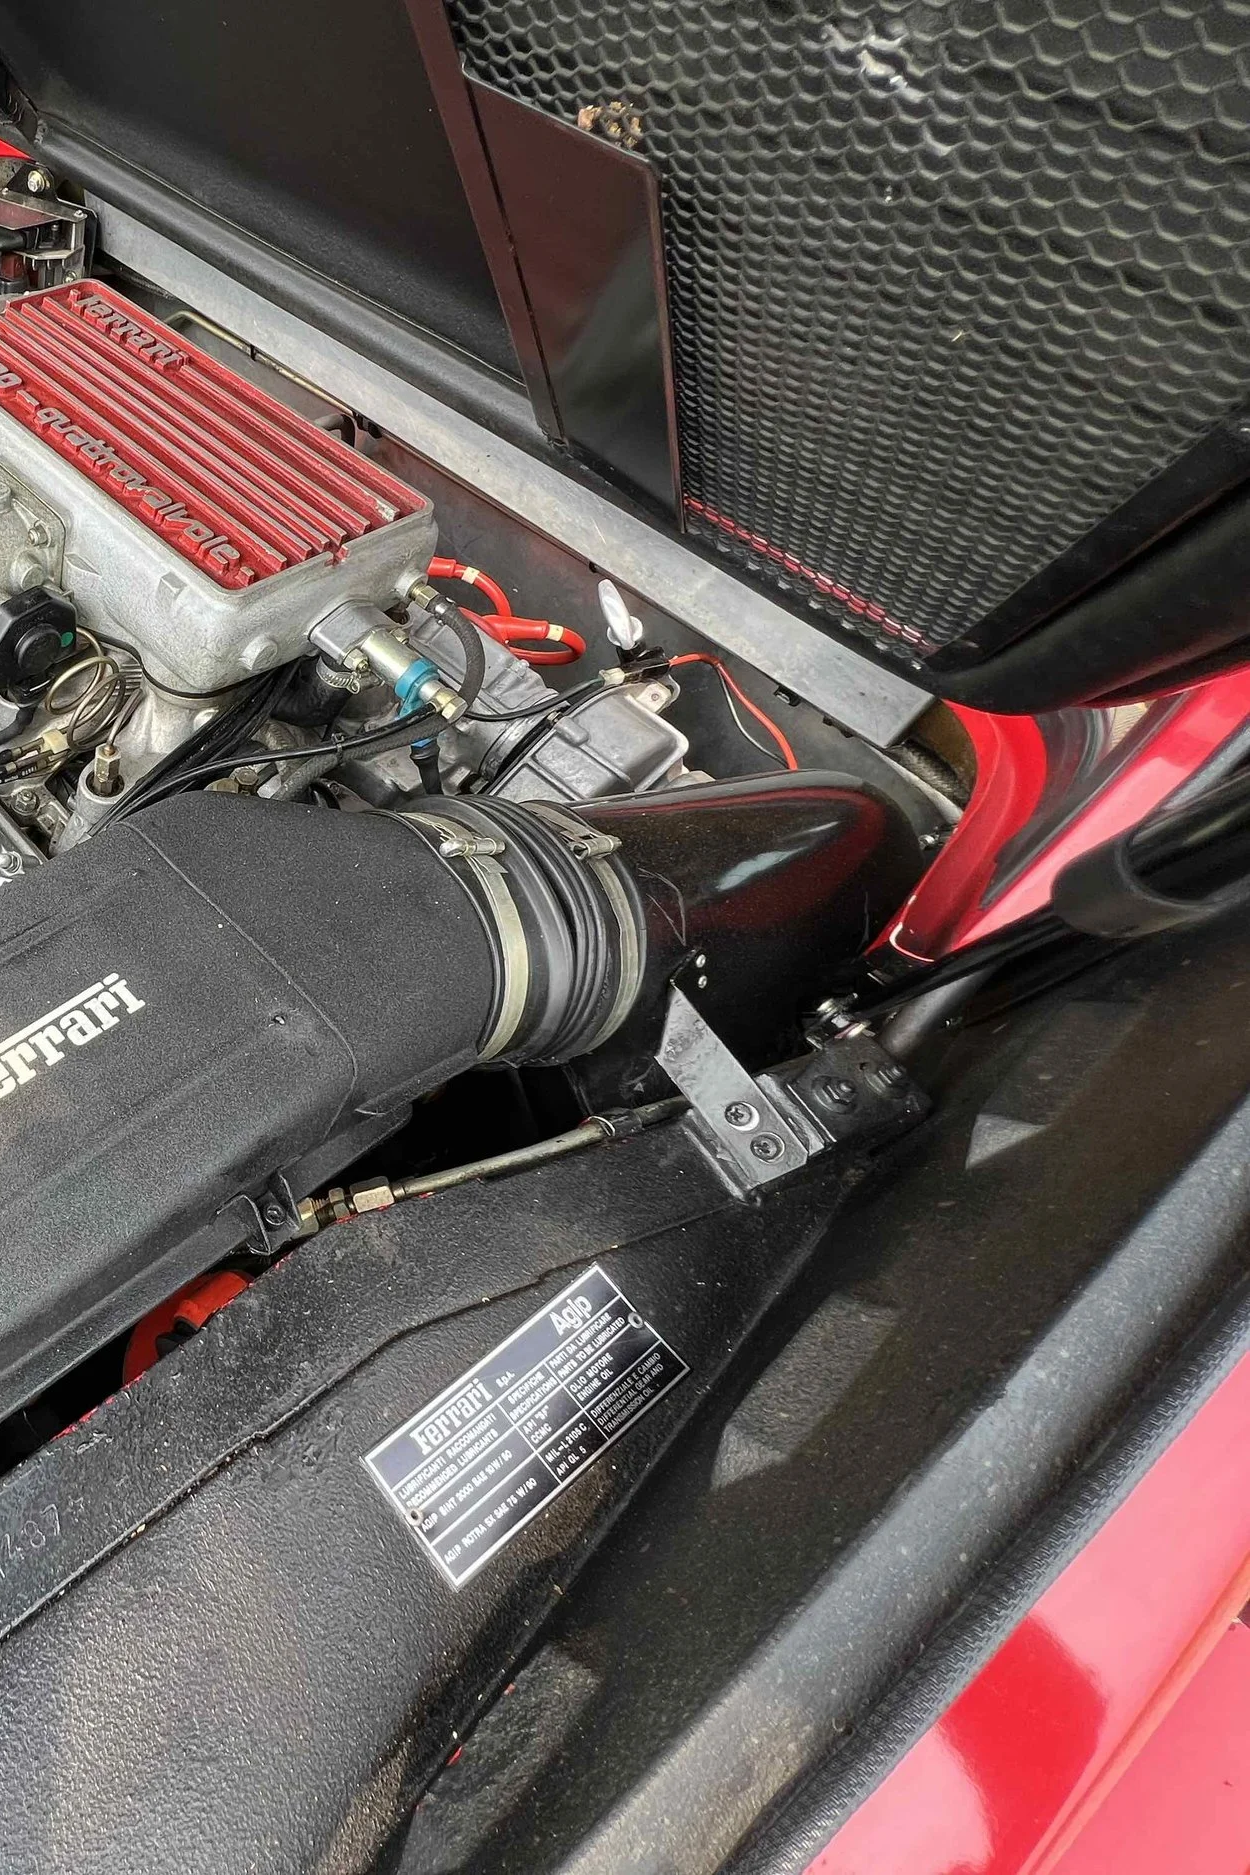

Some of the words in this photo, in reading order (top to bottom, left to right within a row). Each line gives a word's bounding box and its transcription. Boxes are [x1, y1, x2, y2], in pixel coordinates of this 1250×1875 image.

[72, 294, 189, 371] Ferrari
[549, 1296, 592, 1336] Agip
[548, 1352, 569, 1369] PARTI
[565, 1343, 578, 1355] DA
[575, 1312, 612, 1347] LUBRIFICARE
[557, 1358, 578, 1379] PARTS
[575, 1348, 587, 1362] TO
[585, 1344, 595, 1356] BE
[591, 1316, 626, 1349] LUBRICATED
[507, 1370, 545, 1405] SPECIFICHE
[569, 1375, 587, 1394] OLIO
[585, 1352, 614, 1379] MOTORE
[576, 1378, 602, 1402] ENGINE
[599, 1367, 614, 1380] OIL
[590, 1377, 634, 1419] DIFFERENZIALE
[630, 1373, 639, 1382] E
[637, 1352, 661, 1374] CAMBIO
[596, 1387, 638, 1426] DIFFERENTIAL
[634, 1373, 652, 1390] GEAR
[649, 1363, 664, 1378] AND
[409, 1378, 493, 1456] Ferrari
[509, 1376, 558, 1421] SPECIFICATIONS
[603, 1393, 646, 1433] TRANSMISSION
[642, 1386, 655, 1398] OIL
[456, 1428, 499, 1467] LUBRICANTS
[522, 1418, 537, 1435] API
[530, 1422, 552, 1444] CCMC
[398, 1455, 447, 1500] LUBRIFICANTI
[445, 1412, 497, 1460] RACCOMANDATI
[555, 1460, 570, 1477] API
[421, 1512, 439, 1532] AGIP
[438, 1496, 458, 1517] SINT
[455, 1481, 474, 1502] 2000
[471, 1469, 489, 1488] SAE
[443, 1544, 462, 1565] AGIP
[461, 1523, 488, 1548] ROTRA
[483, 1514, 497, 1528] SX
[493, 1502, 510, 1519] SAE
[506, 1493, 518, 1505] 75
